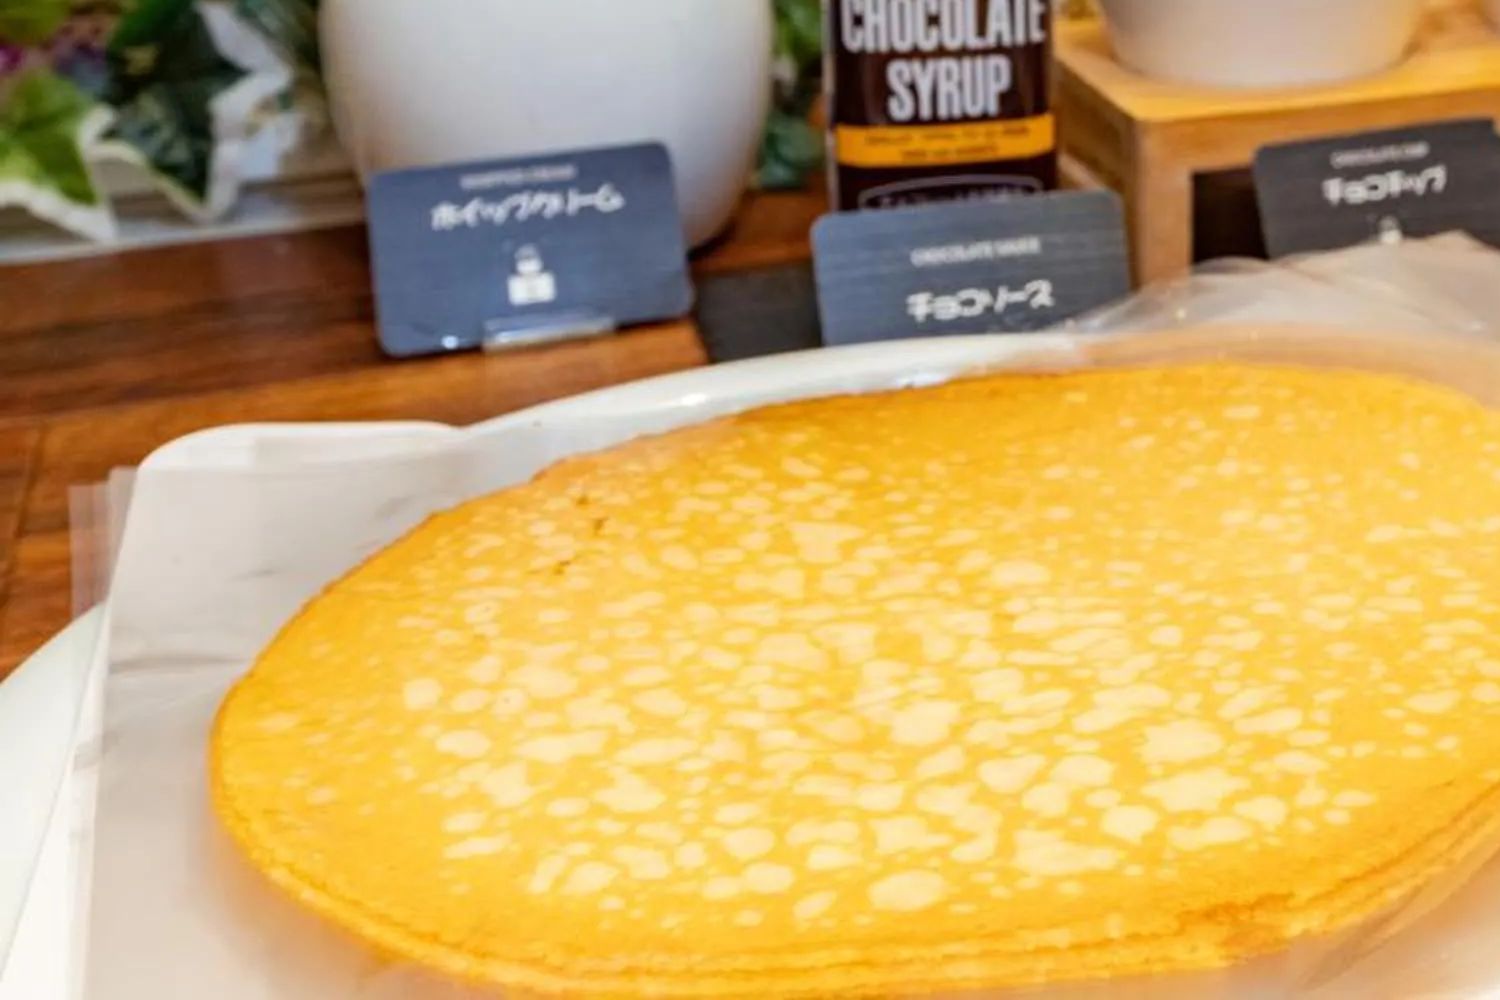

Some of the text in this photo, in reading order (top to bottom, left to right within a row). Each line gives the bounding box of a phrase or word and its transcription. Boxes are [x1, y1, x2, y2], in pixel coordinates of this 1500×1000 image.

[887, 54, 1011, 121] SYRUP
[906, 279, 1055, 322] チョコソース
